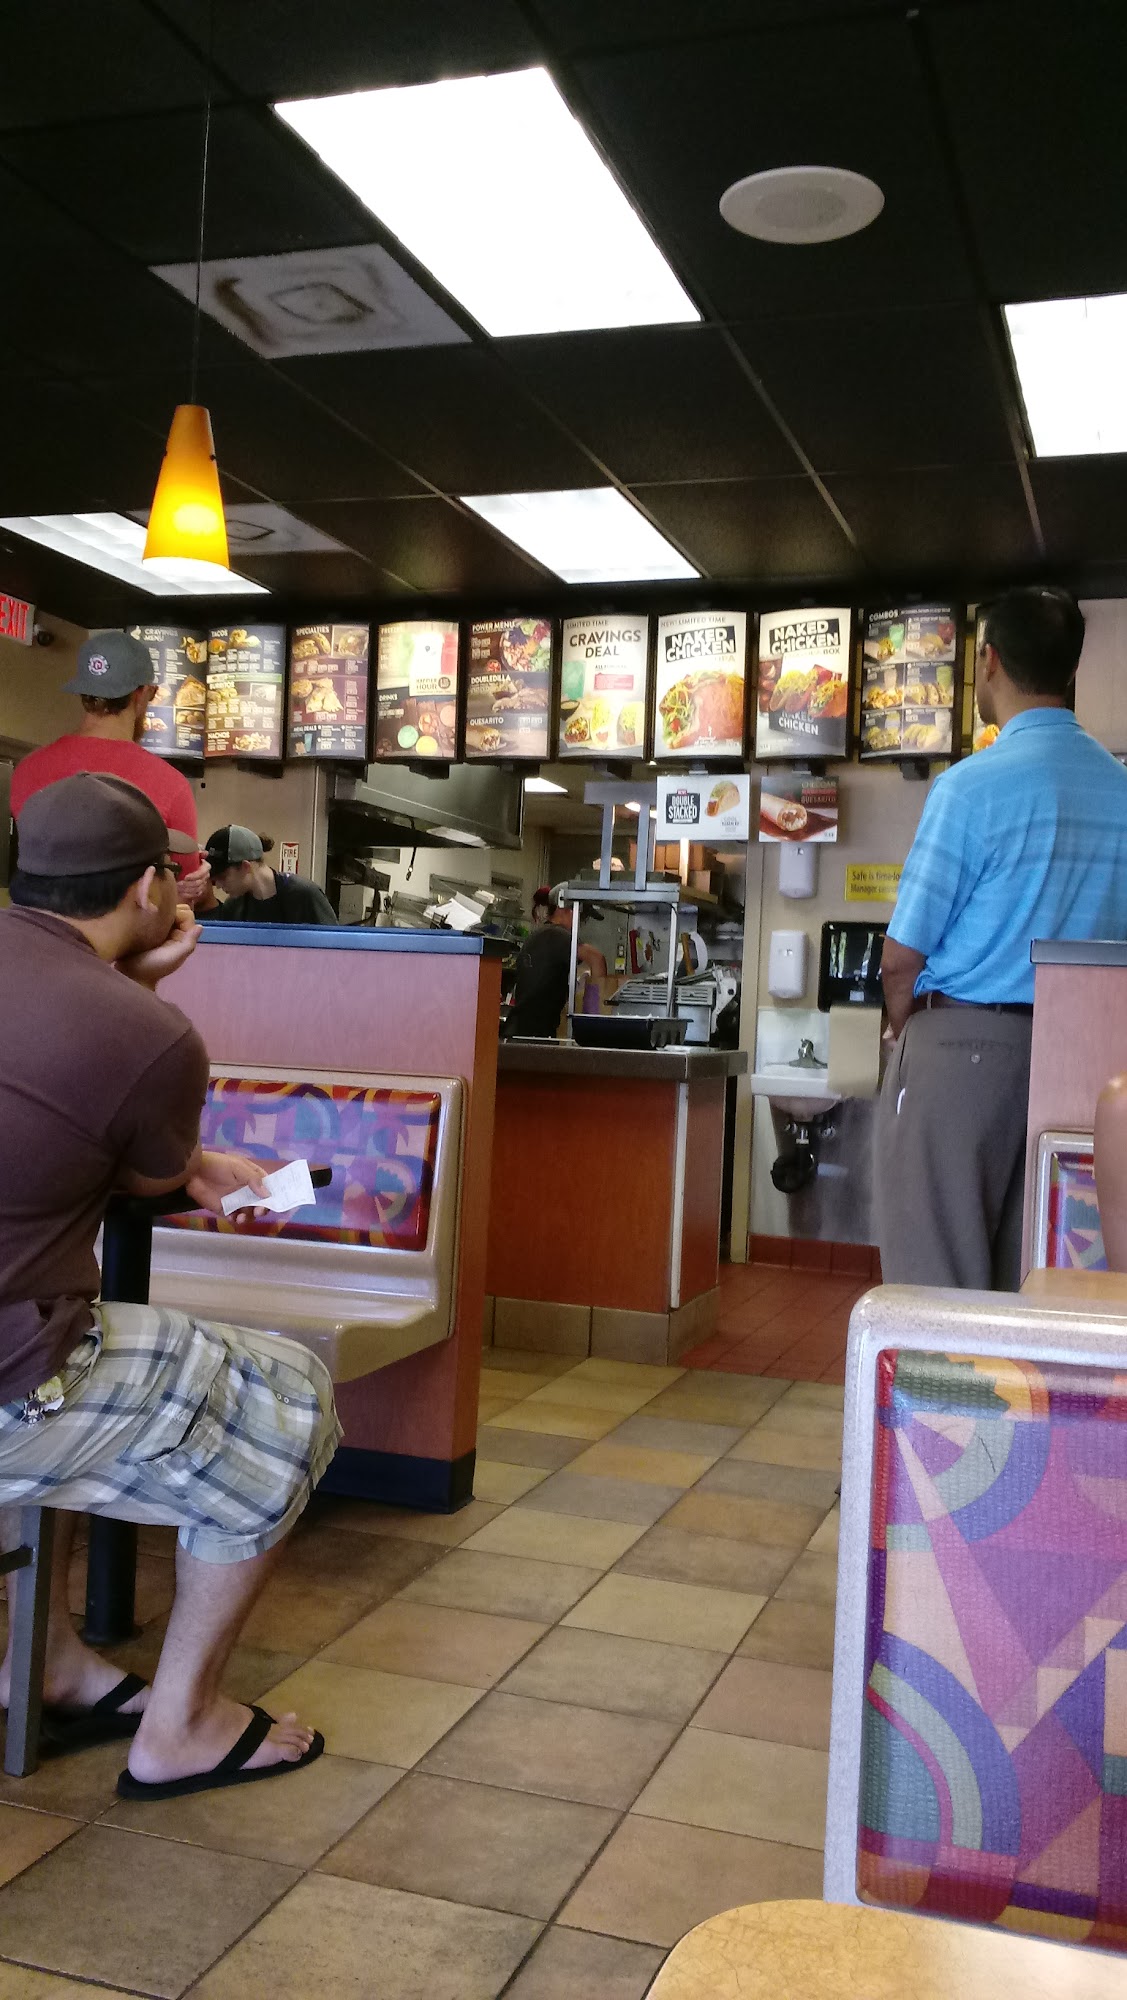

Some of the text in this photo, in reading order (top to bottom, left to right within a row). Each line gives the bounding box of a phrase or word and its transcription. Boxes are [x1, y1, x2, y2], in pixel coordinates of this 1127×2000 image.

[0, 595, 29, 641] EXIT
[868, 609, 899, 622] COMBOS
[472, 620, 515, 632] POWER MENU
[566, 619, 608, 629] LIMITED TIME
[211, 629, 228, 637] TACOS
[774, 620, 829, 642] NAKED
[143, 634, 164, 642] MENU
[569, 629, 642, 648] CRAVINGS
[671, 627, 728, 649] NAKED
[771, 632, 839, 655] CHICKEN
[585, 645, 620, 659] DEAL
[666, 639, 735, 662] CHICKEN
[823, 647, 840, 655] BOX
[470, 674, 511, 685] DOUBLEDILLA
[379, 694, 398, 702] DRINKS
[469, 716, 505, 727] QUESARITO
[778, 717, 819, 736] CHICKEN
[207, 731, 230, 740] NACHOS
[671, 795, 695, 806] DOUBLE
[668, 805, 698, 820] STACKED
[283, 848, 297, 858] FIRE
[852, 870, 867, 881] Safe
[850, 882, 879, 896] Manager
